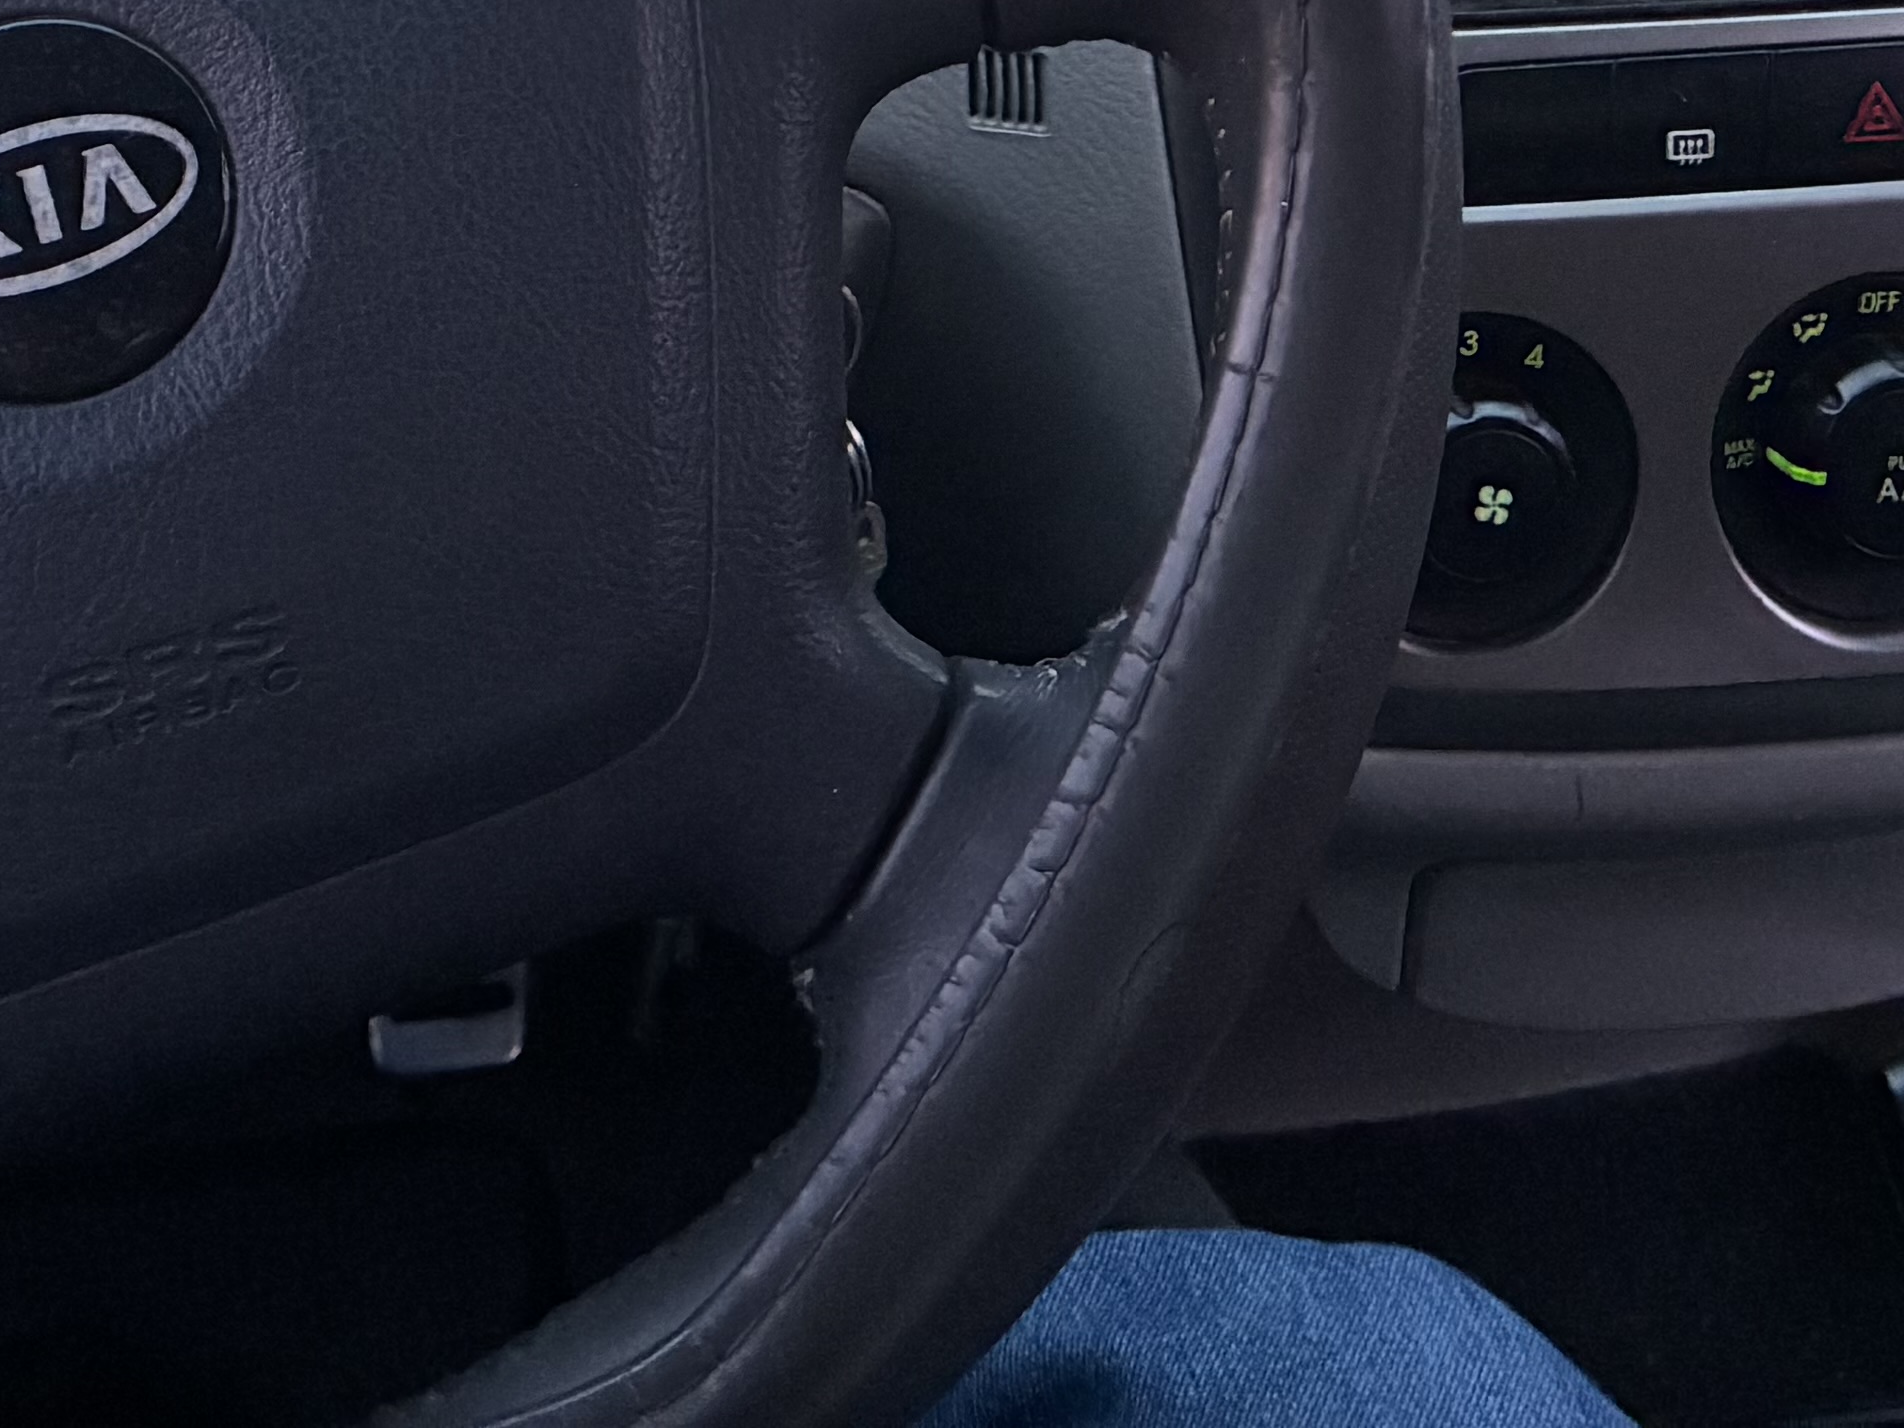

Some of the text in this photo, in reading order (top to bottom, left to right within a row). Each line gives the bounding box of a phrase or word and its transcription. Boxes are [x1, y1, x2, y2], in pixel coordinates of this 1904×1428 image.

[1857, 290, 1902, 315] OFF
[1459, 330, 1479, 356] 3
[1524, 344, 1544, 369] 4
[40, 605, 289, 728] SRS
